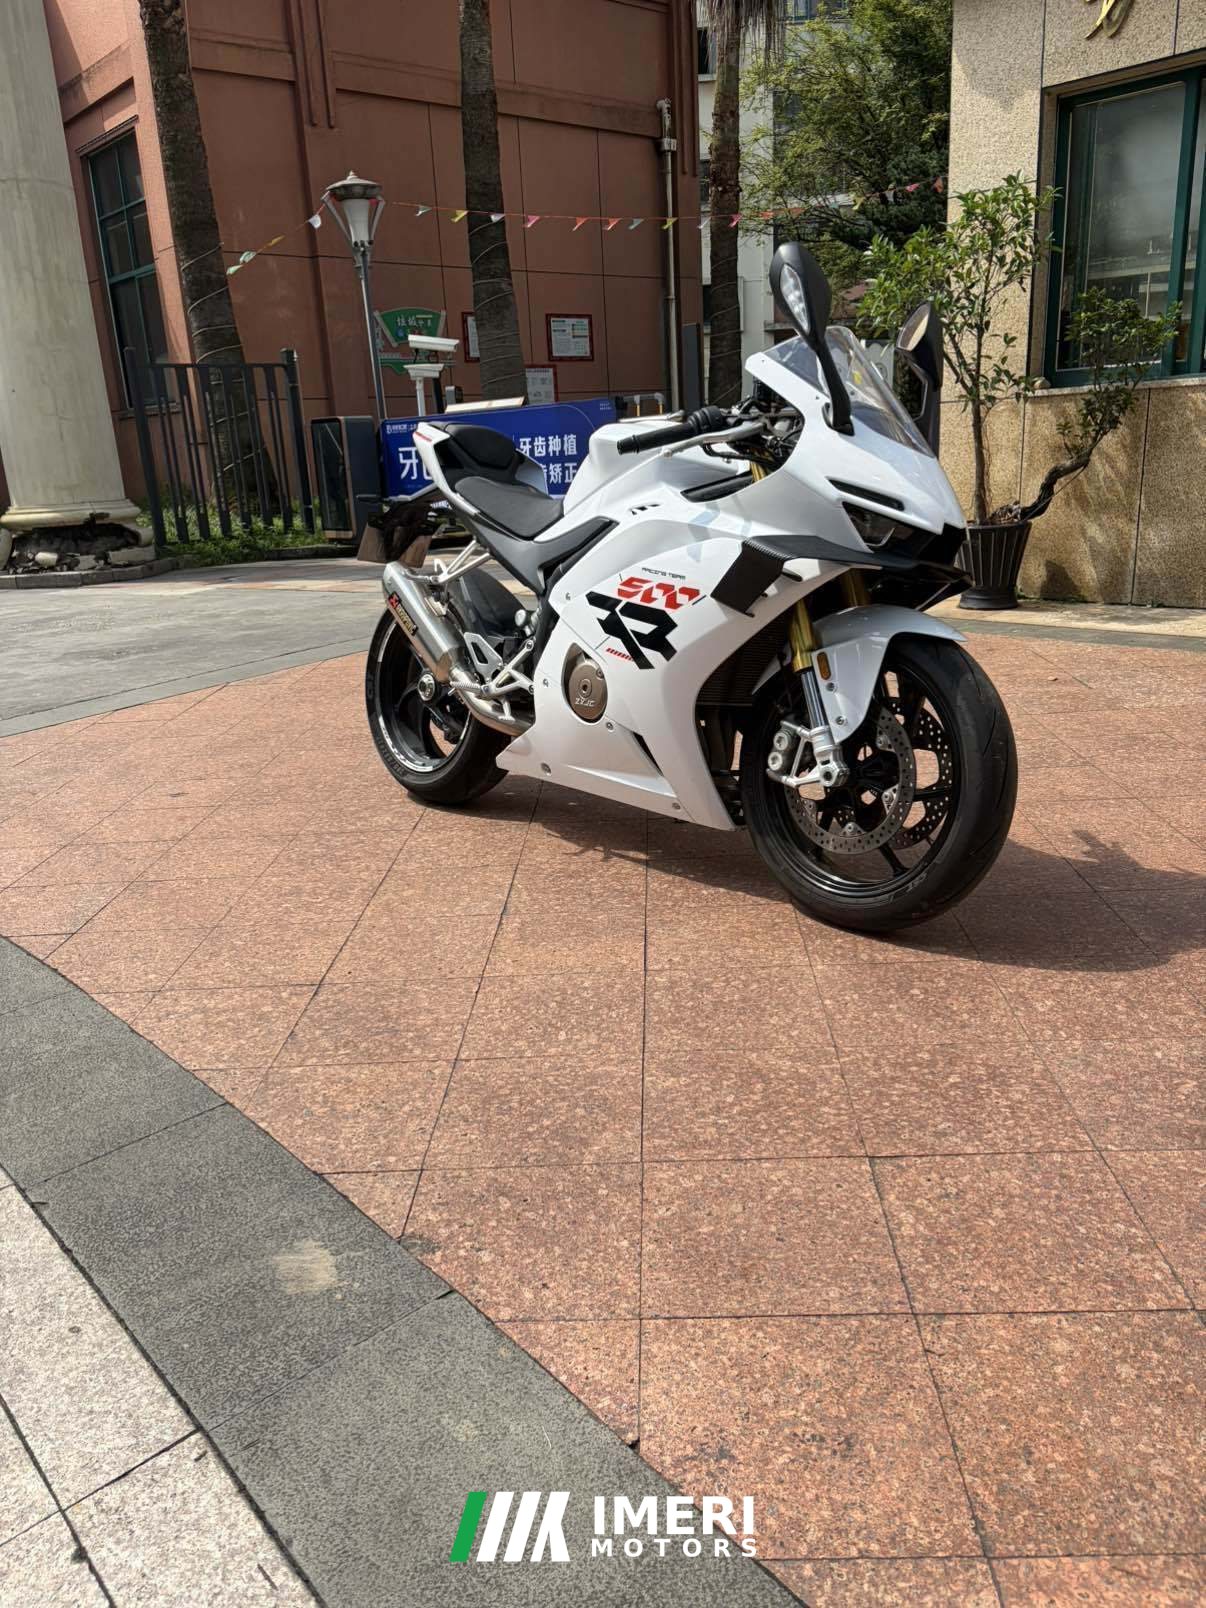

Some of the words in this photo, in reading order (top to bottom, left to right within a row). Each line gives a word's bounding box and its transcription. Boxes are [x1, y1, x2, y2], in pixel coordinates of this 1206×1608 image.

[519, 434, 577, 457] 牙齿种植
[642, 567, 667, 577] RACING
[668, 572, 686, 580] TEAM
[617, 576, 700, 610] 500
